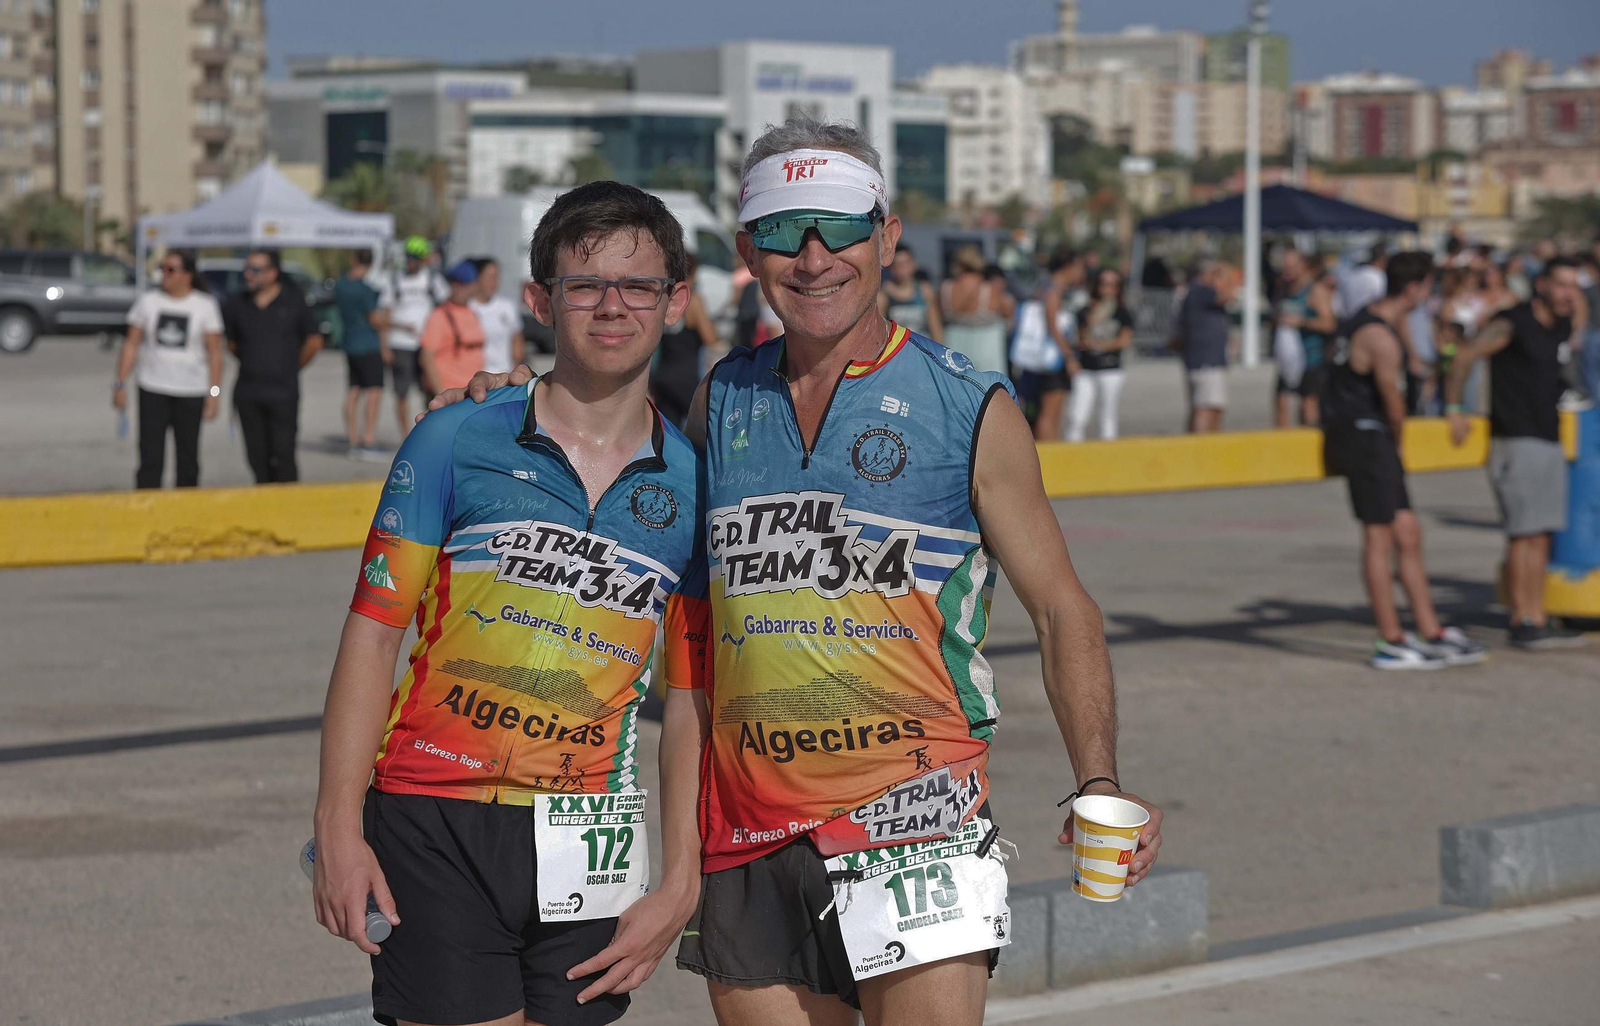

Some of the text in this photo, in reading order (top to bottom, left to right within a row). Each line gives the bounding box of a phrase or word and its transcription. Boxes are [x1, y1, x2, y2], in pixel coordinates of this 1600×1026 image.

[782, 163, 815, 183] TRI
[866, 429, 885, 437] TRAIL
[886, 431, 902, 445] TEAM
[857, 468, 891, 482] ALGECIRAS
[635, 513, 664, 528] ALGECIRAS
[744, 500, 836, 544] TRAIL
[530, 528, 614, 565] TRAIL
[502, 554, 580, 588] TEAM
[725, 548, 816, 588] TEAM
[500, 604, 569, 638] Gabarras
[571, 627, 583, 644] &
[743, 614, 920, 641] Gabarras & Servicio
[533, 631, 608, 667] www.gys.es
[782, 639, 877, 656] www.gys.es
[434, 684, 606, 747] Algeciras
[414, 739, 482, 769] El Cerezo Rojo
[739, 718, 925, 763] Algeciras
[548, 796, 615, 813] XXVI
[551, 813, 644, 825] VIRGEN DEL PIL
[873, 808, 942, 837] TEAM
[580, 826, 634, 871] 172
[743, 828, 786, 844] Cerezo
[862, 843, 979, 880] RGEN DEL PILAR
[586, 873, 627, 885] OSCAR SAEZ
[884, 862, 959, 917] 173
[541, 907, 572, 916] Algeciras
[897, 914, 940, 932] CANDELA
[941, 908, 965, 924] SAEZ
[854, 958, 894, 974] Algeciras
[862, 954, 883, 963] Puerto
